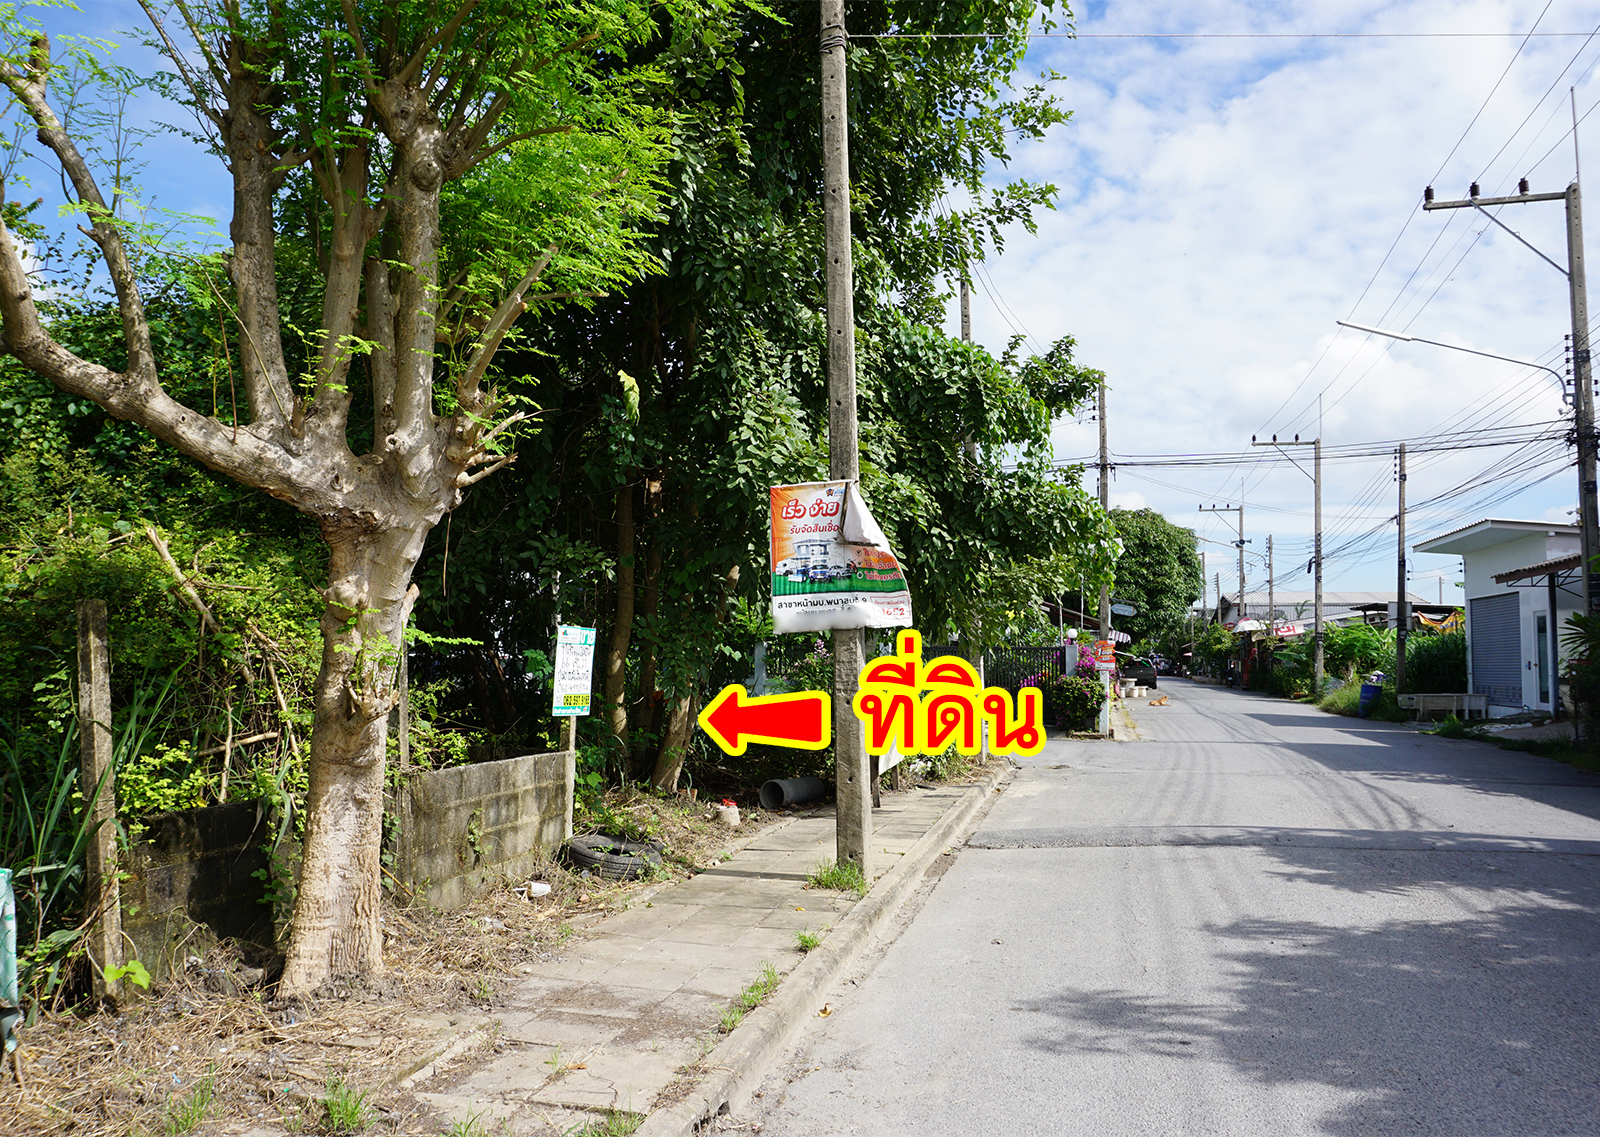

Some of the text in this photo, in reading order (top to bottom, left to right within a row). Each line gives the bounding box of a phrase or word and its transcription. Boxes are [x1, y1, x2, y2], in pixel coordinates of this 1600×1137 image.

[781, 498, 840, 519] เร็ว ง่าย
[790, 520, 839, 534] รับจัดสินเชื่อ
[882, 607, 905, 616] 1652
